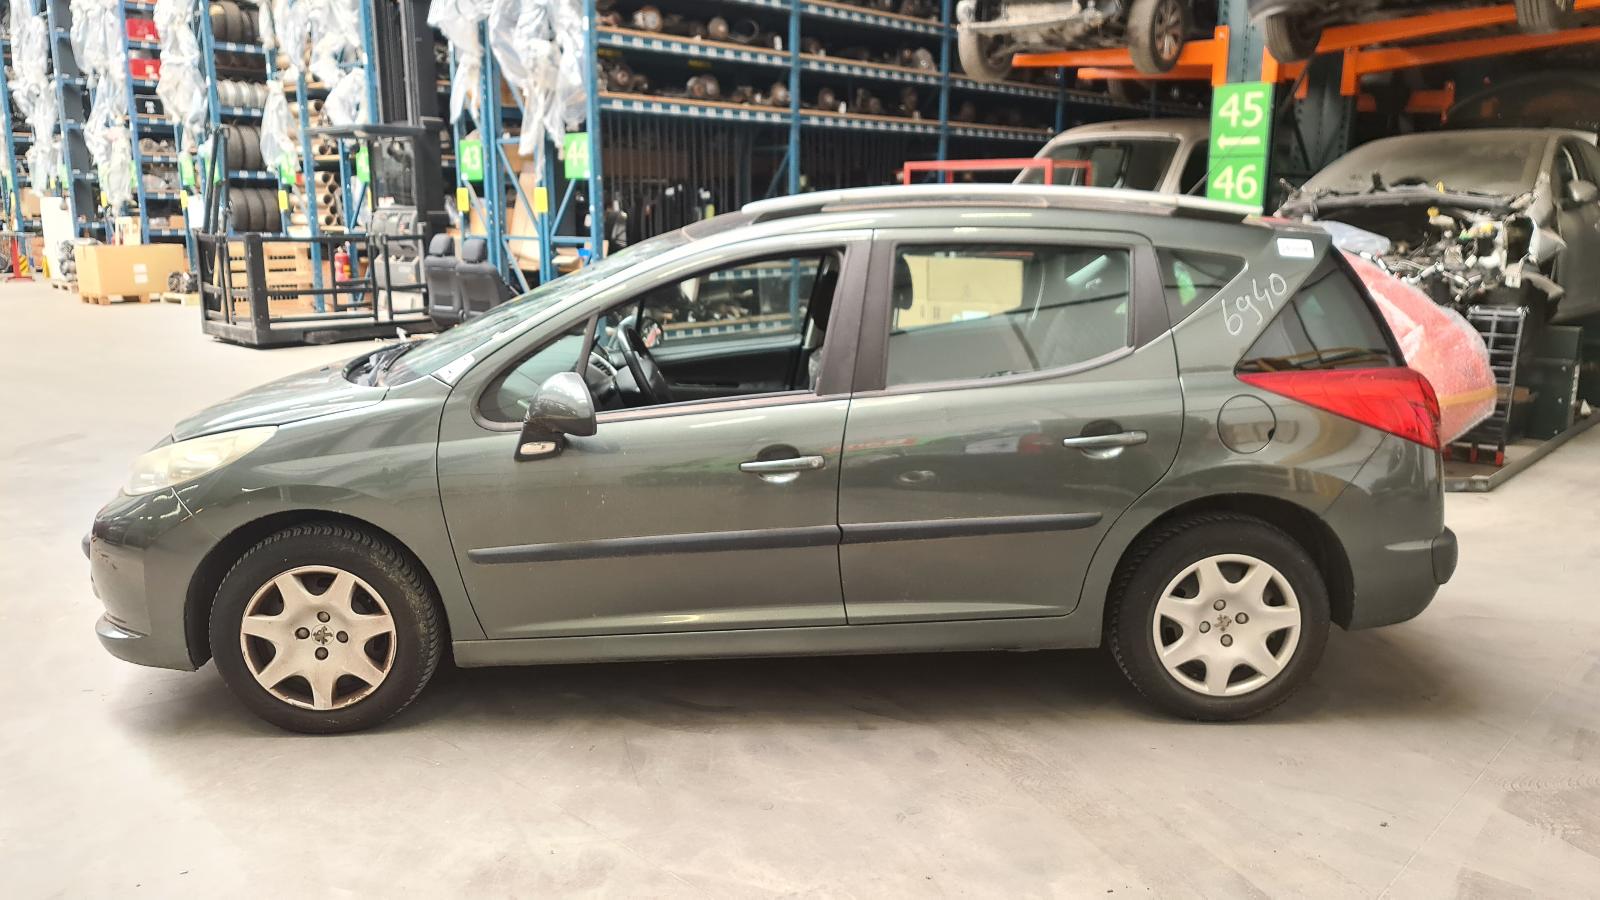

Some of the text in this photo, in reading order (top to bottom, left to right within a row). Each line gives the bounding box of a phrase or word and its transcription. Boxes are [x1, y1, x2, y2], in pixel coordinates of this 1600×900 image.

[1218, 90, 1264, 128] 45
[462, 145, 480, 171] 43
[566, 140, 589, 166] 44
[1212, 163, 1258, 200] 46
[1221, 272, 1287, 336] 6940
